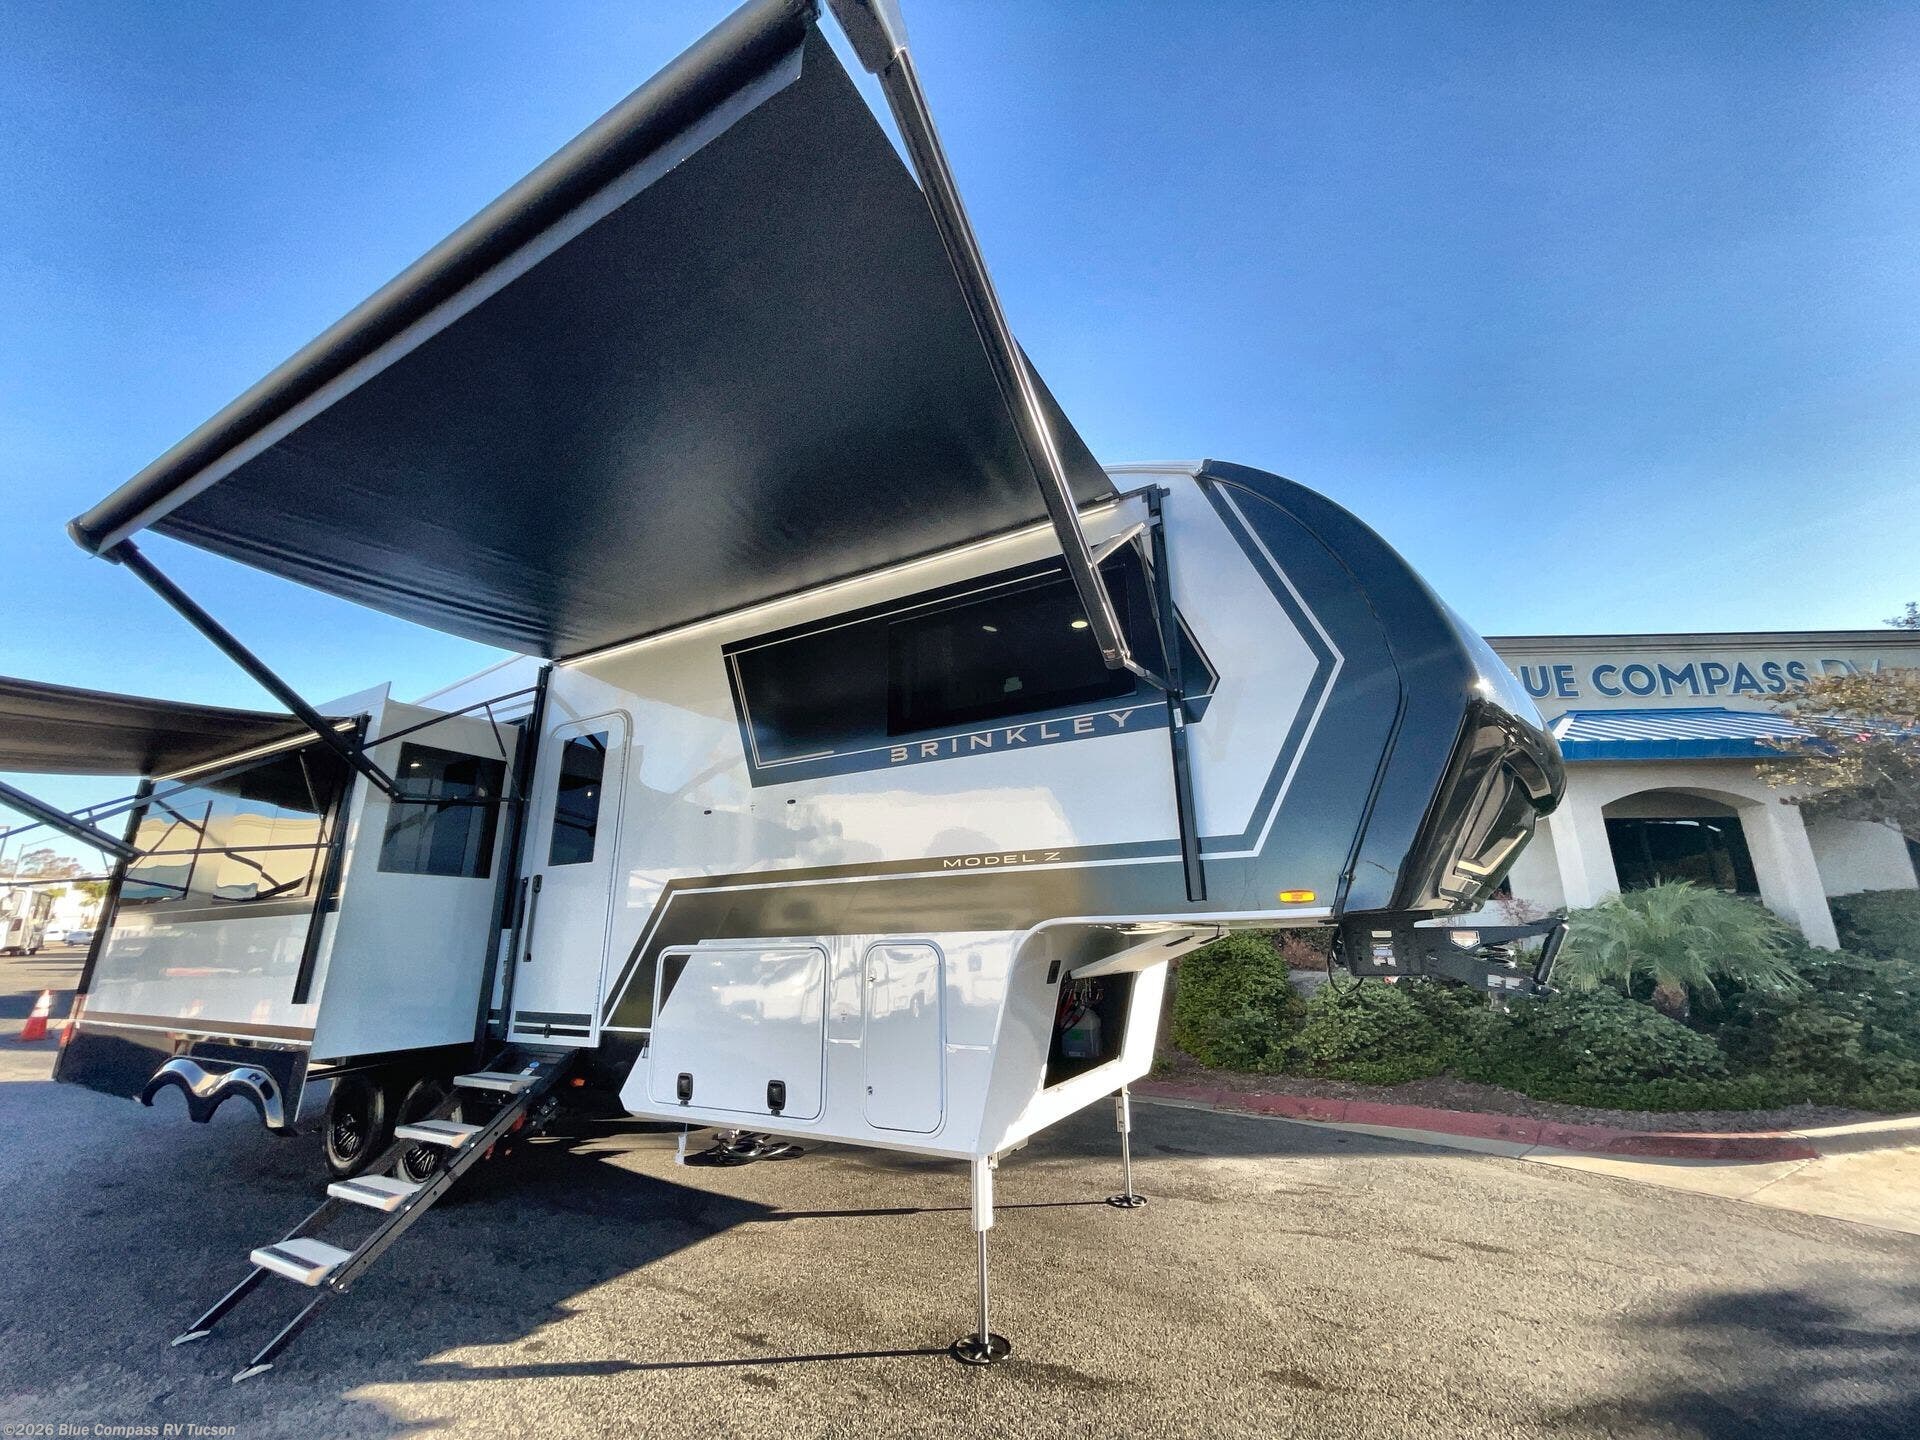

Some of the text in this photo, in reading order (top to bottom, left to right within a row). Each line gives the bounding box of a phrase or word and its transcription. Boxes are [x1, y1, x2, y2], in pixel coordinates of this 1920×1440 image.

[1518, 663, 1580, 699] UE
[1590, 660, 1812, 698] COMPASS
[890, 710, 1133, 763] BRINKLEY
[943, 851, 1061, 868] MODEL Z
